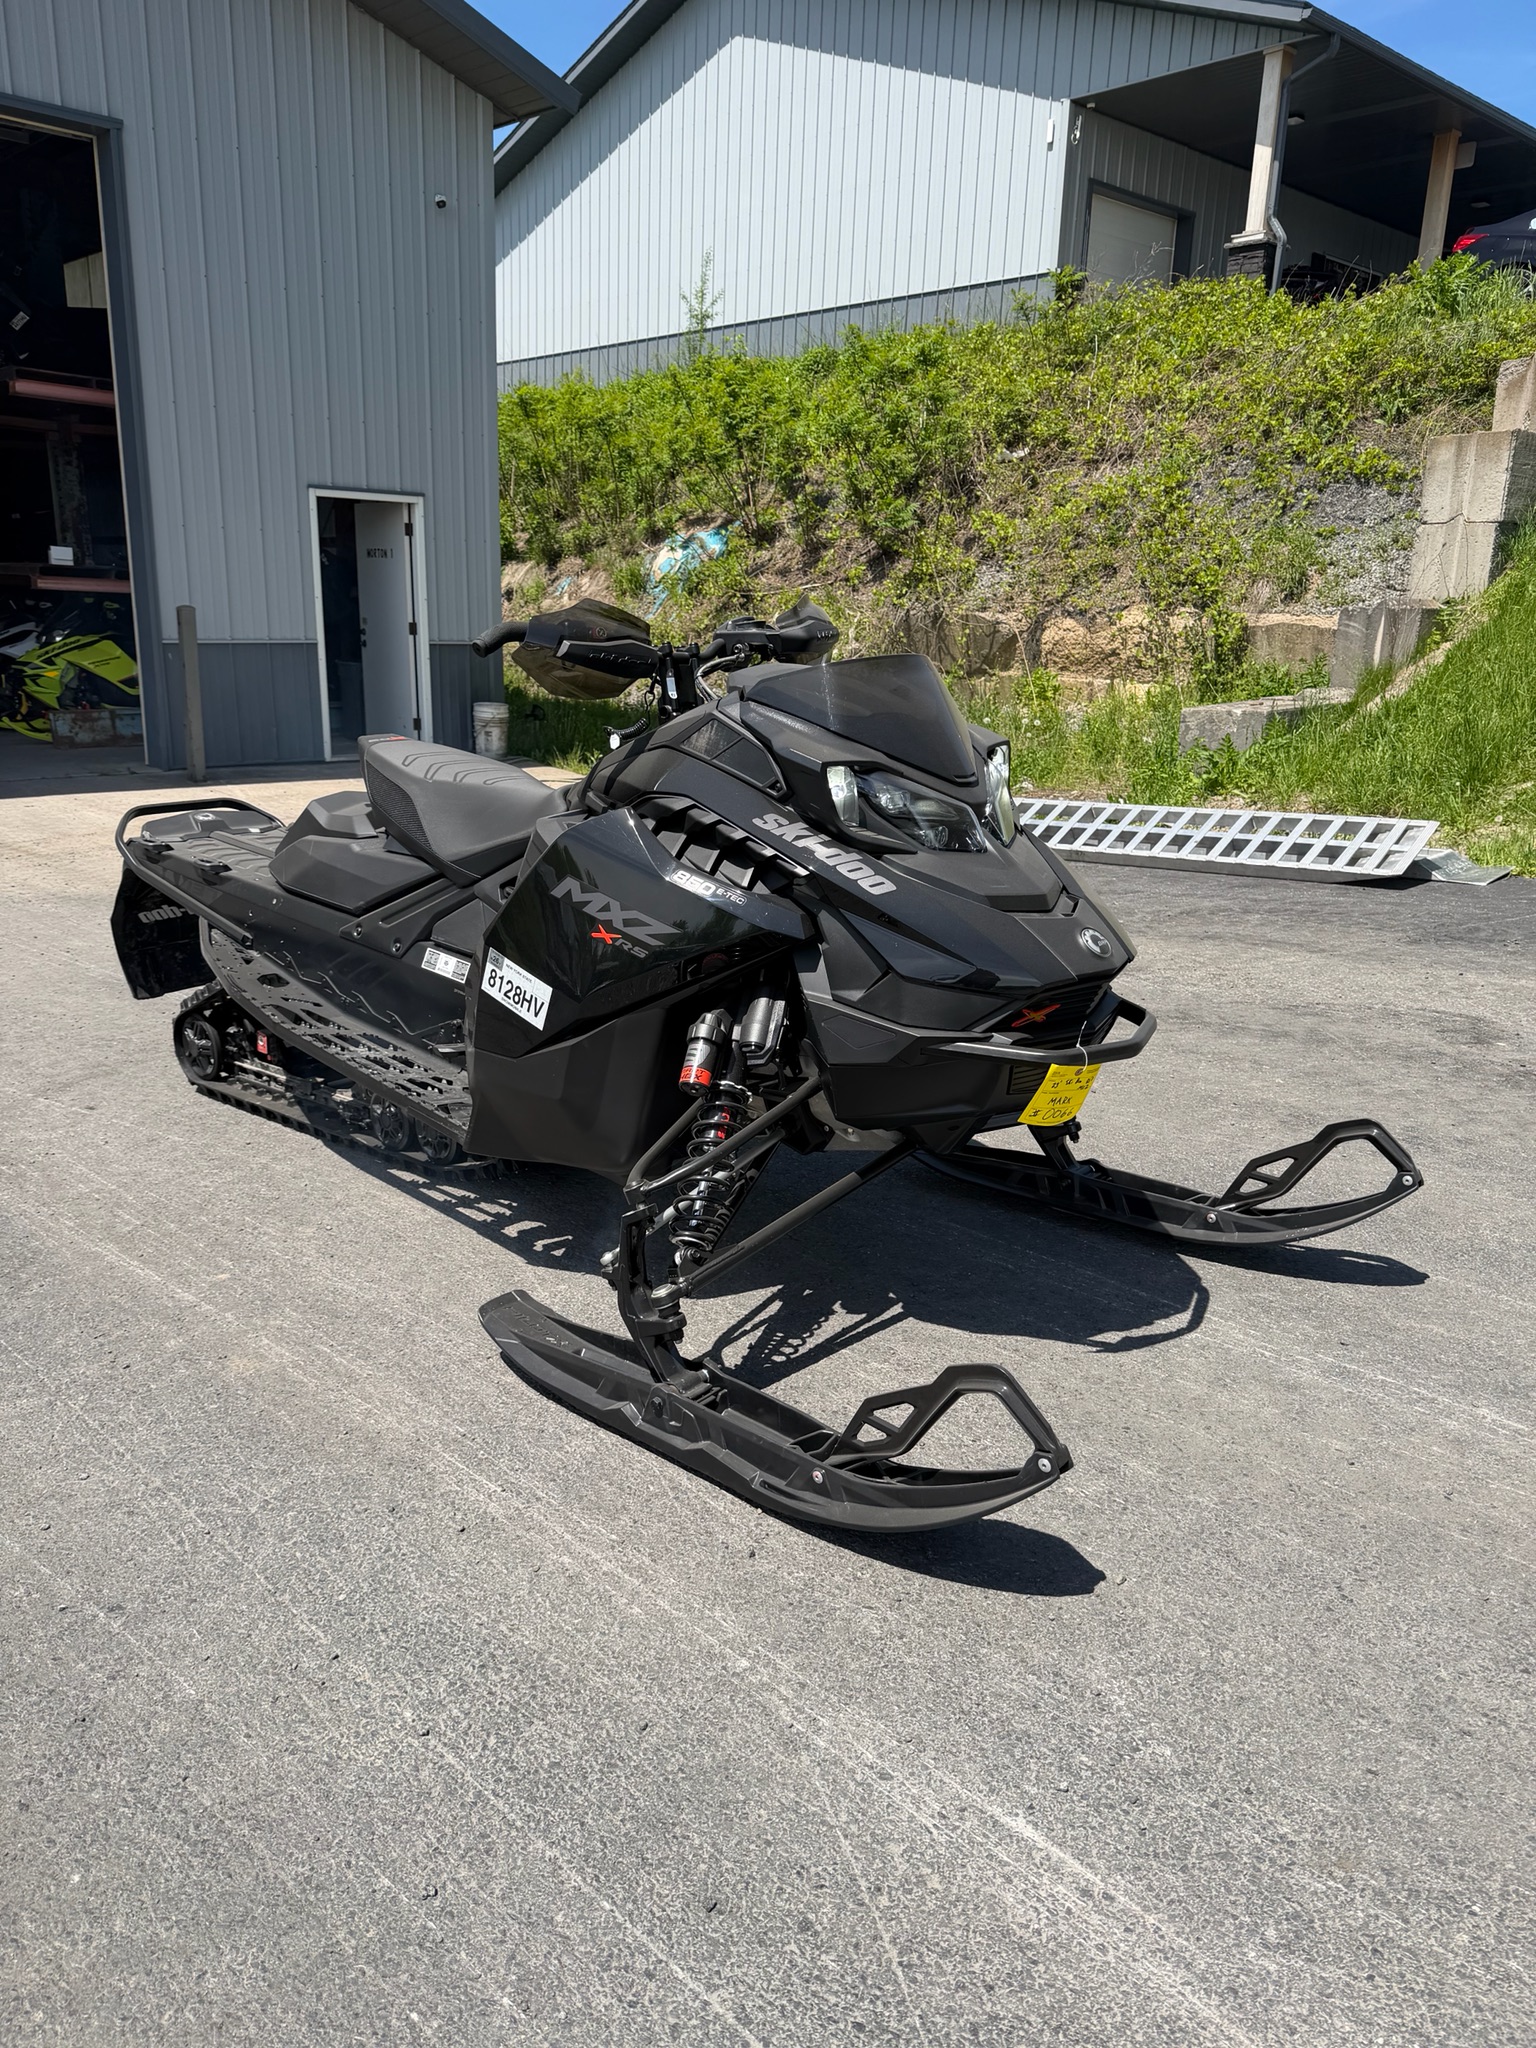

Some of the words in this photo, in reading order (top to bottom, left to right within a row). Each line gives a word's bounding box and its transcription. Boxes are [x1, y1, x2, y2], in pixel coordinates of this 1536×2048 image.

[672, 869, 716, 897] 850
[716, 888, 745, 905] E-TEC
[551, 876, 682, 946] MXZ
[488, 968, 545, 1018] 8128HV
[1047, 1096, 1073, 1106] MARK
